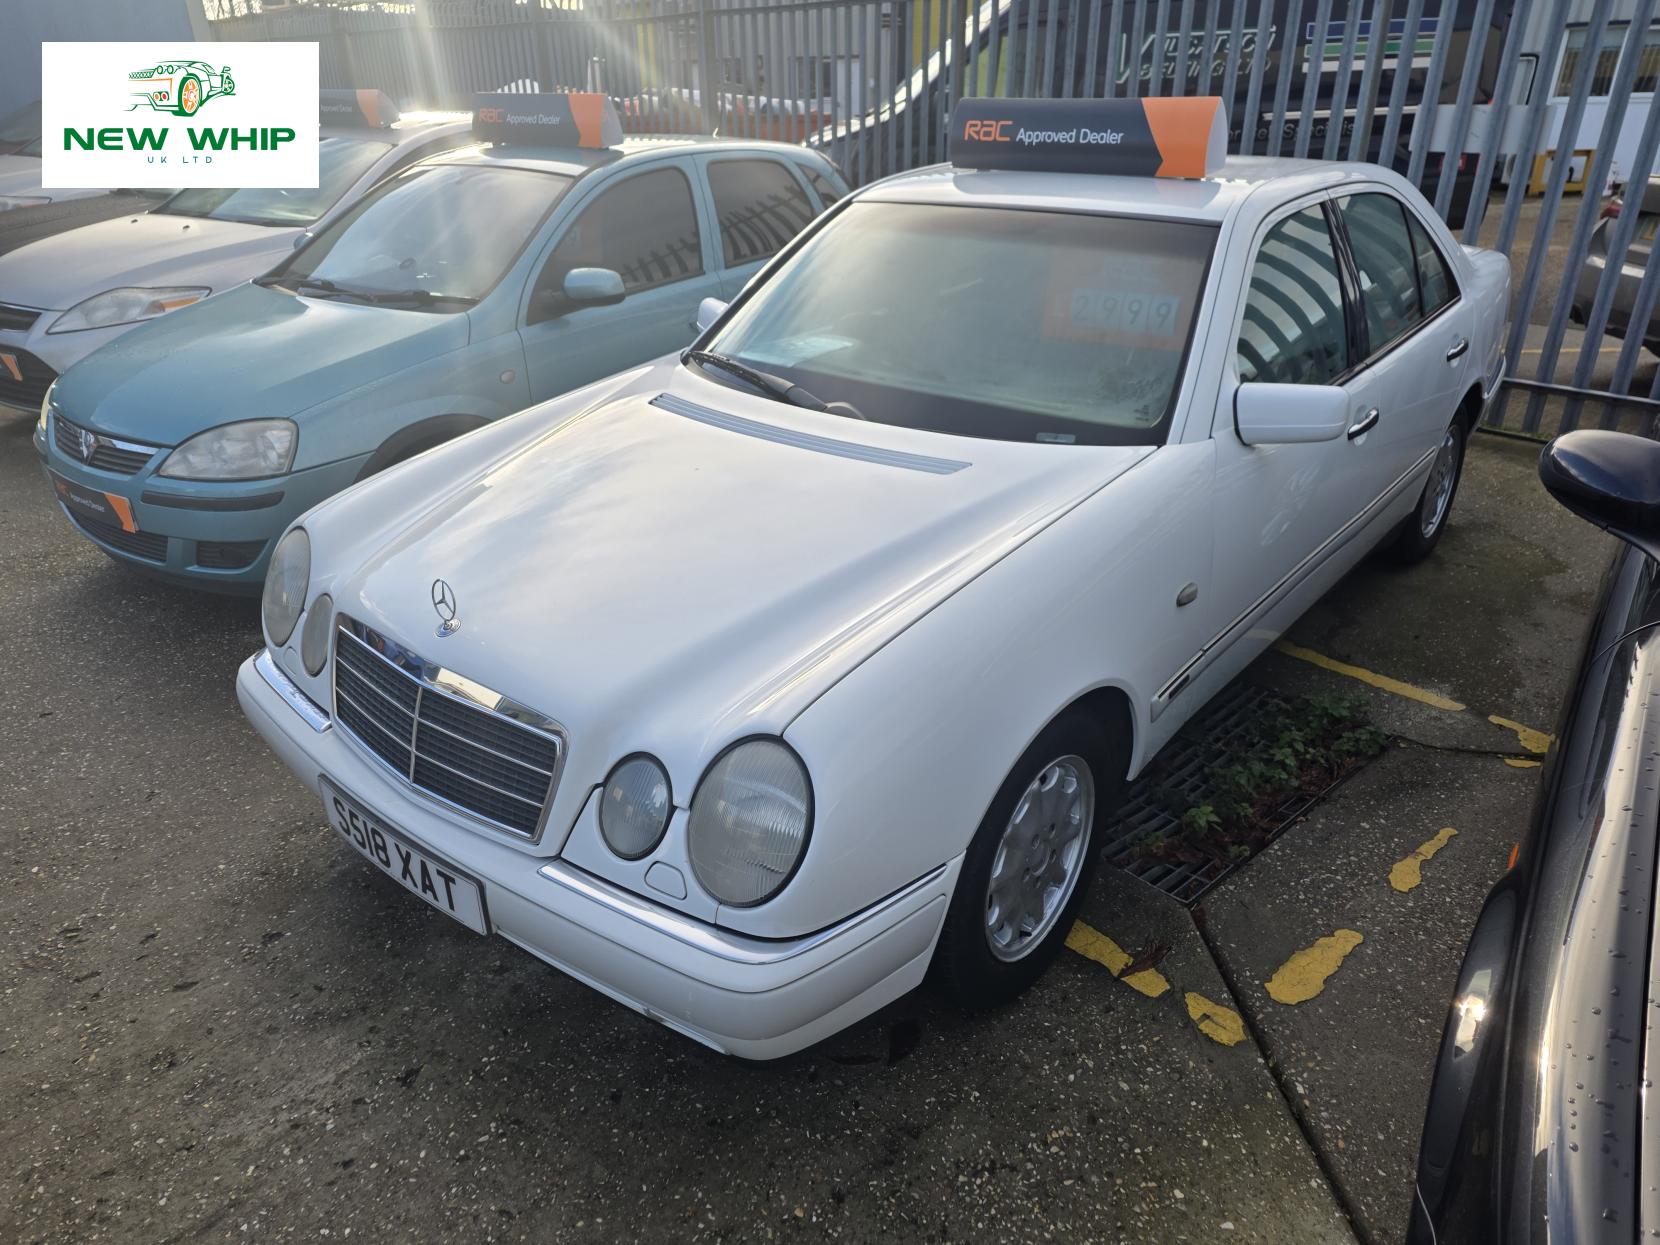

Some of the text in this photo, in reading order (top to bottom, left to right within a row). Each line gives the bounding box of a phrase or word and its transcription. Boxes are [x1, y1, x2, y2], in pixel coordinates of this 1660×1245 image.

[506, 113, 537, 125] Approved
[538, 113, 560, 124] Dealer
[1015, 127, 1076, 146] Approved
[1079, 128, 1124, 144] Dealer
[333, 796, 456, 911] S518 XAT
